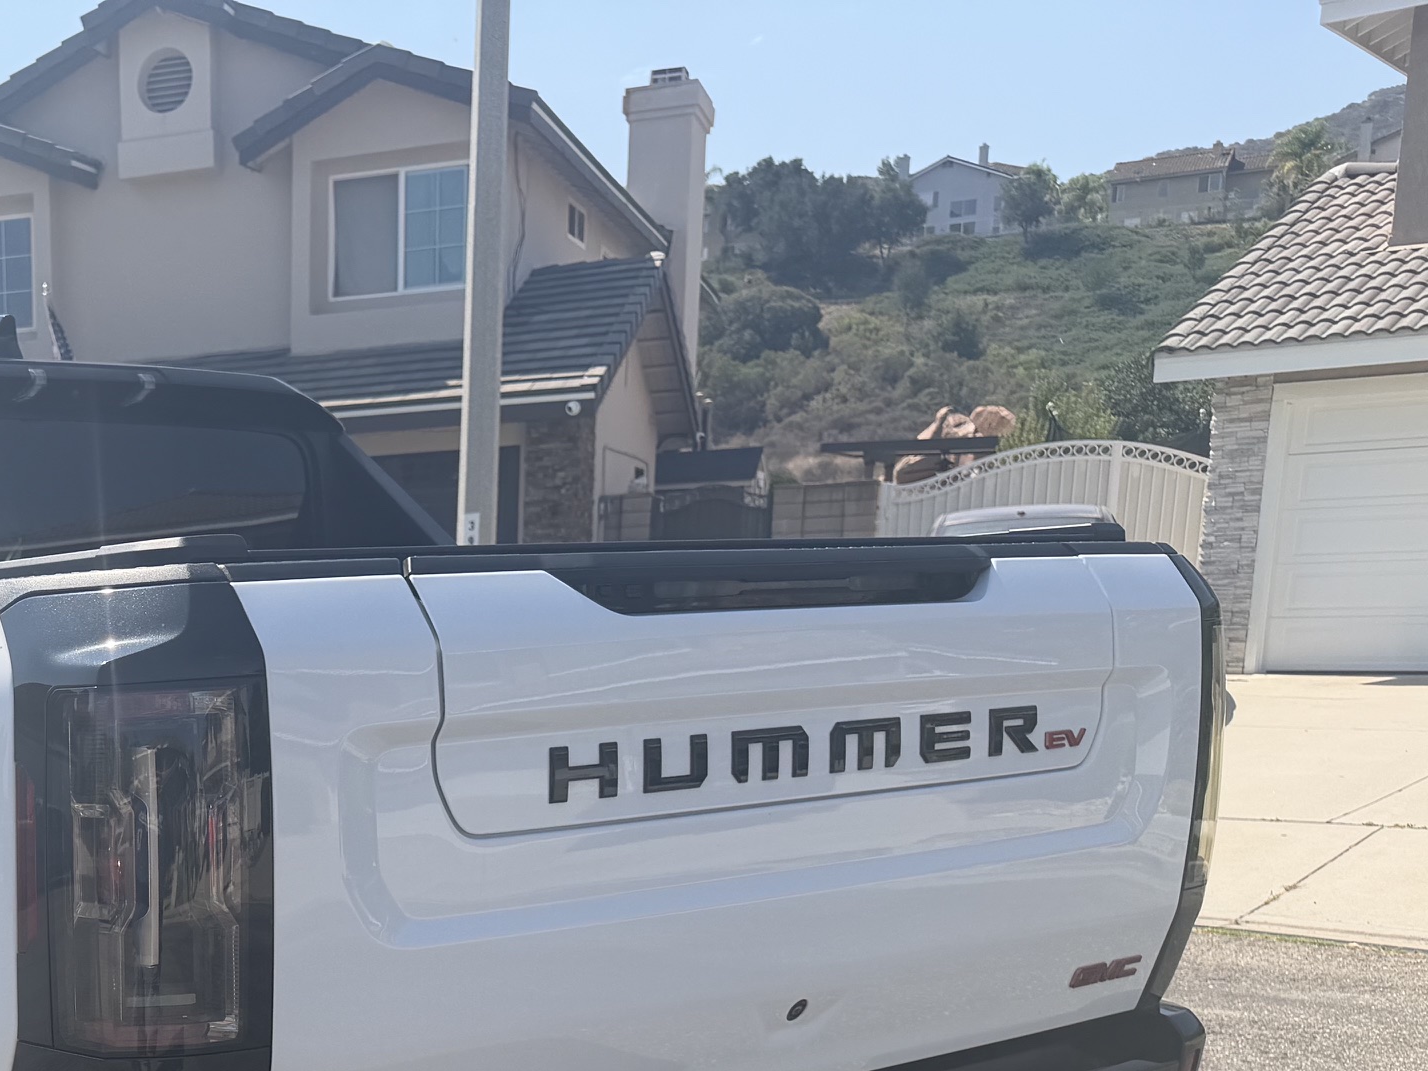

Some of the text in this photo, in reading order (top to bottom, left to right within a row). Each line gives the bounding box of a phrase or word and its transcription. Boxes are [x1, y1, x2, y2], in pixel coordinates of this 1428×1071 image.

[548, 705, 1087, 804] HUMMER EV
[1068, 954, 1143, 989] GMC
